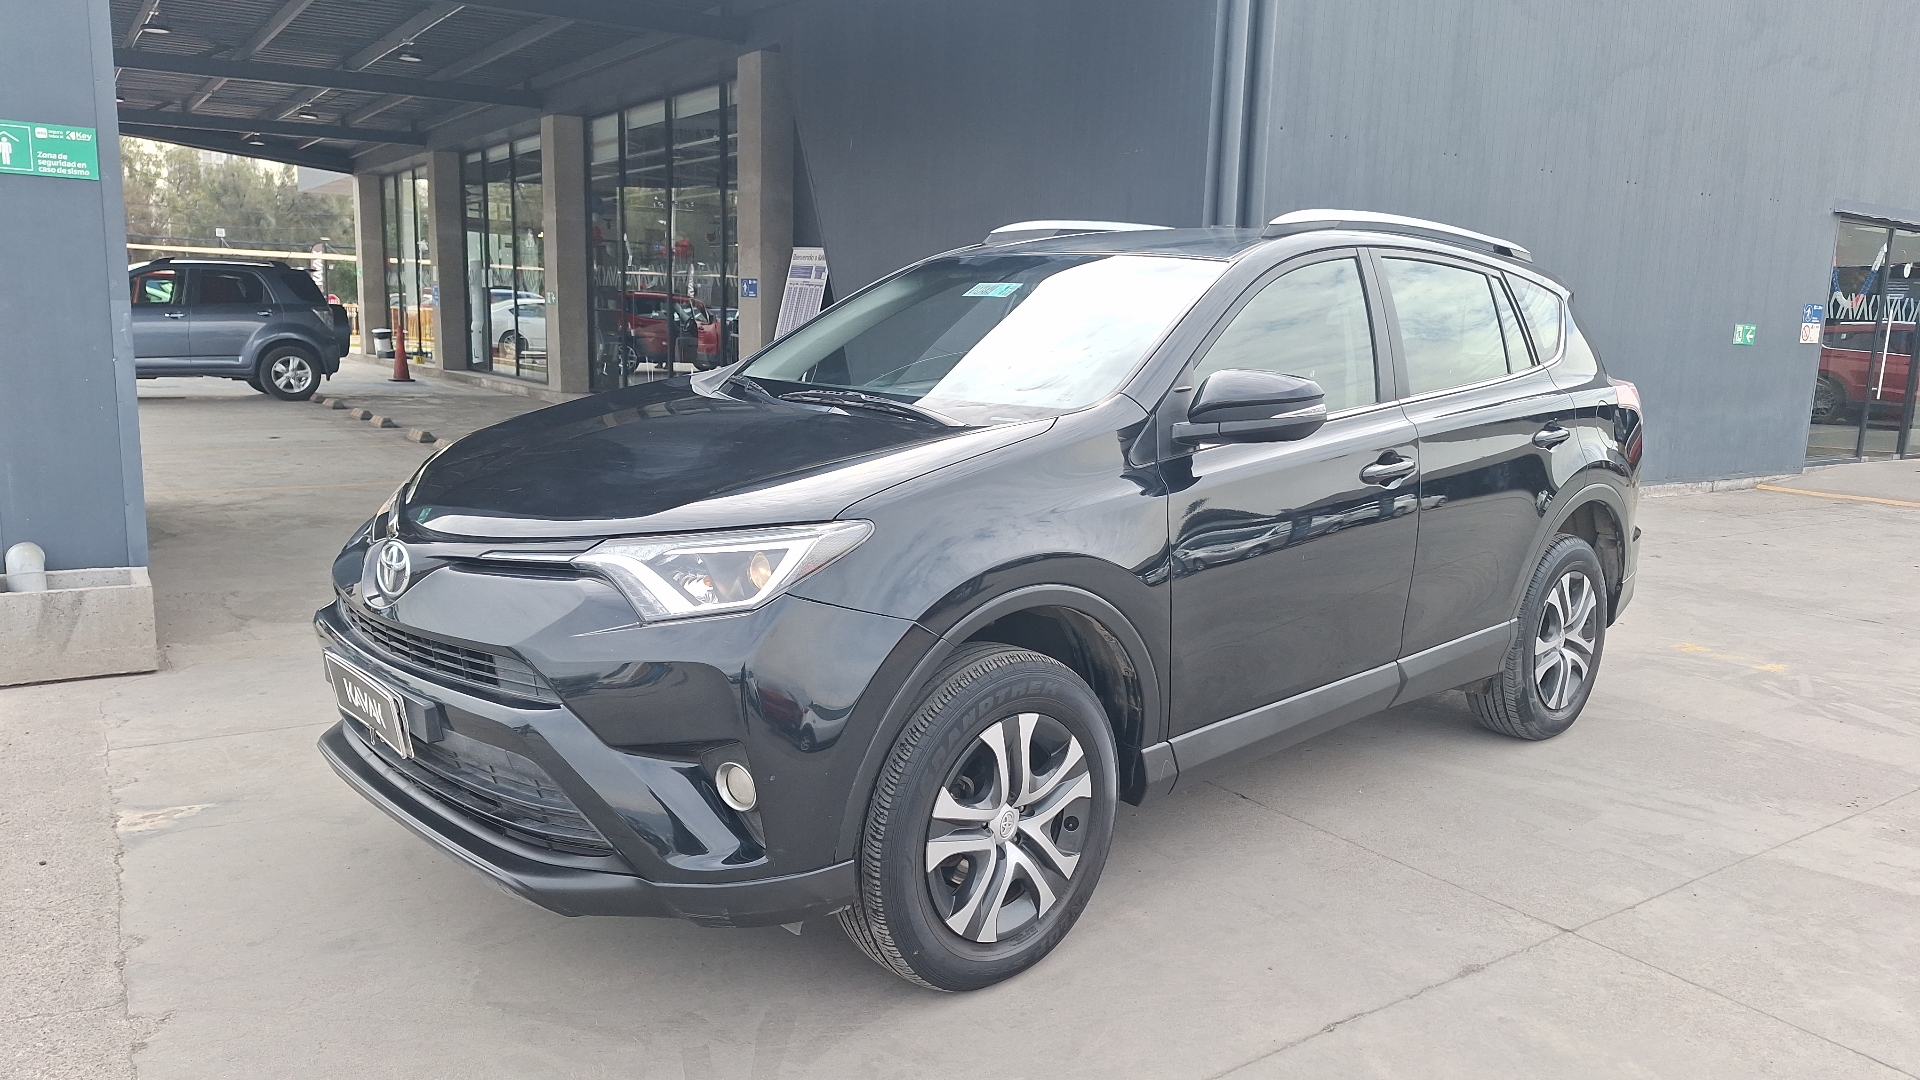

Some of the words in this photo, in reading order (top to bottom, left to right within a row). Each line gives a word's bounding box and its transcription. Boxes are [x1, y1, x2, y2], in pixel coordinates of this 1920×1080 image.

[75, 131, 92, 141] Key
[36, 151, 57, 159] Zona
[37, 159, 76, 168] seguridad
[67, 168, 90, 176] sismo
[343, 677, 387, 730] KAVAK
